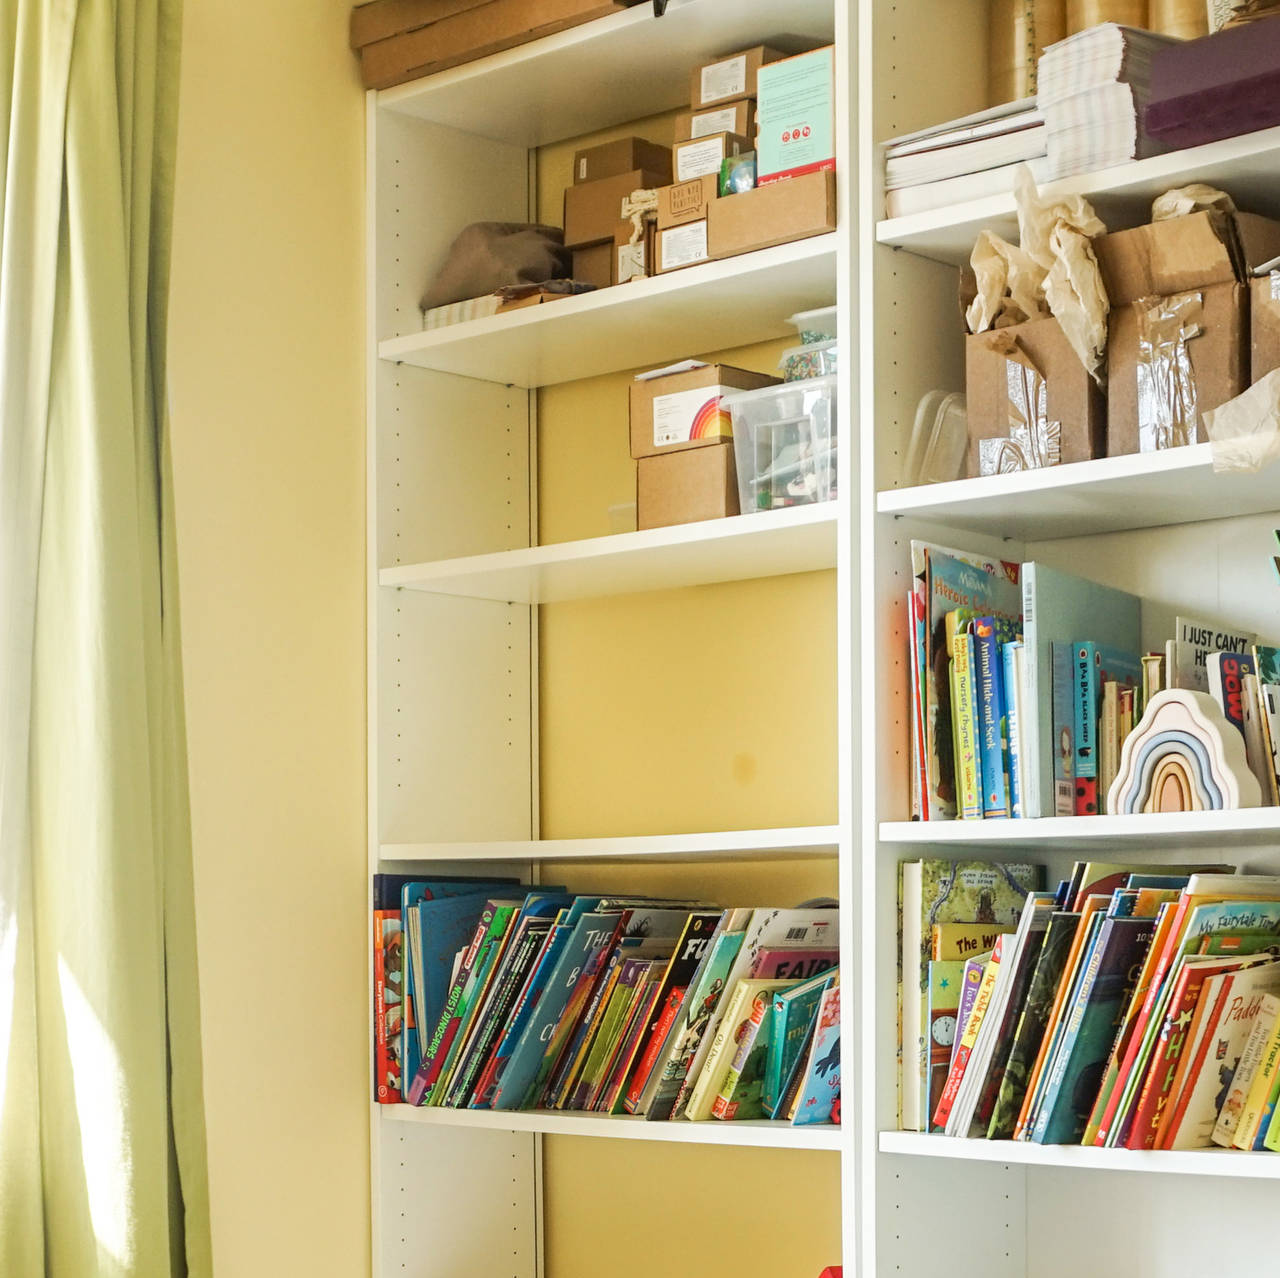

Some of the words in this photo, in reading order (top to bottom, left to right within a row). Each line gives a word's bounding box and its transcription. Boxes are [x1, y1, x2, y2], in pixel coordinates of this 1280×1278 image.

[934, 576, 969, 606] Heroic
[1183, 625, 1187, 642] I
[1189, 627, 1214, 648] JUST
[1215, 632, 1247, 655] CAN'T
[979, 640, 992, 677] Animal
[1194, 649, 1213, 667] HE
[957, 675, 968, 712] nursery
[1223, 658, 1244, 721] MOG
[959, 713, 970, 749] rhymes
[1199, 920, 1214, 936] My
[1218, 911, 1256, 930] Fairytale
[1259, 914, 1276, 929] Tim
[583, 930, 614, 951] THE
[681, 938, 709, 961] FU
[956, 937, 977, 955] The
[775, 958, 833, 980] FAIR
[982, 972, 996, 989] The
[1077, 952, 1102, 1004] Children's
[444, 983, 463, 1012] NOISY
[1223, 995, 1265, 1025] Paddi
[1068, 1005, 1084, 1034] Bible
[424, 1010, 453, 1060] DINOSAURS
[713, 1031, 725, 1047] Oh
